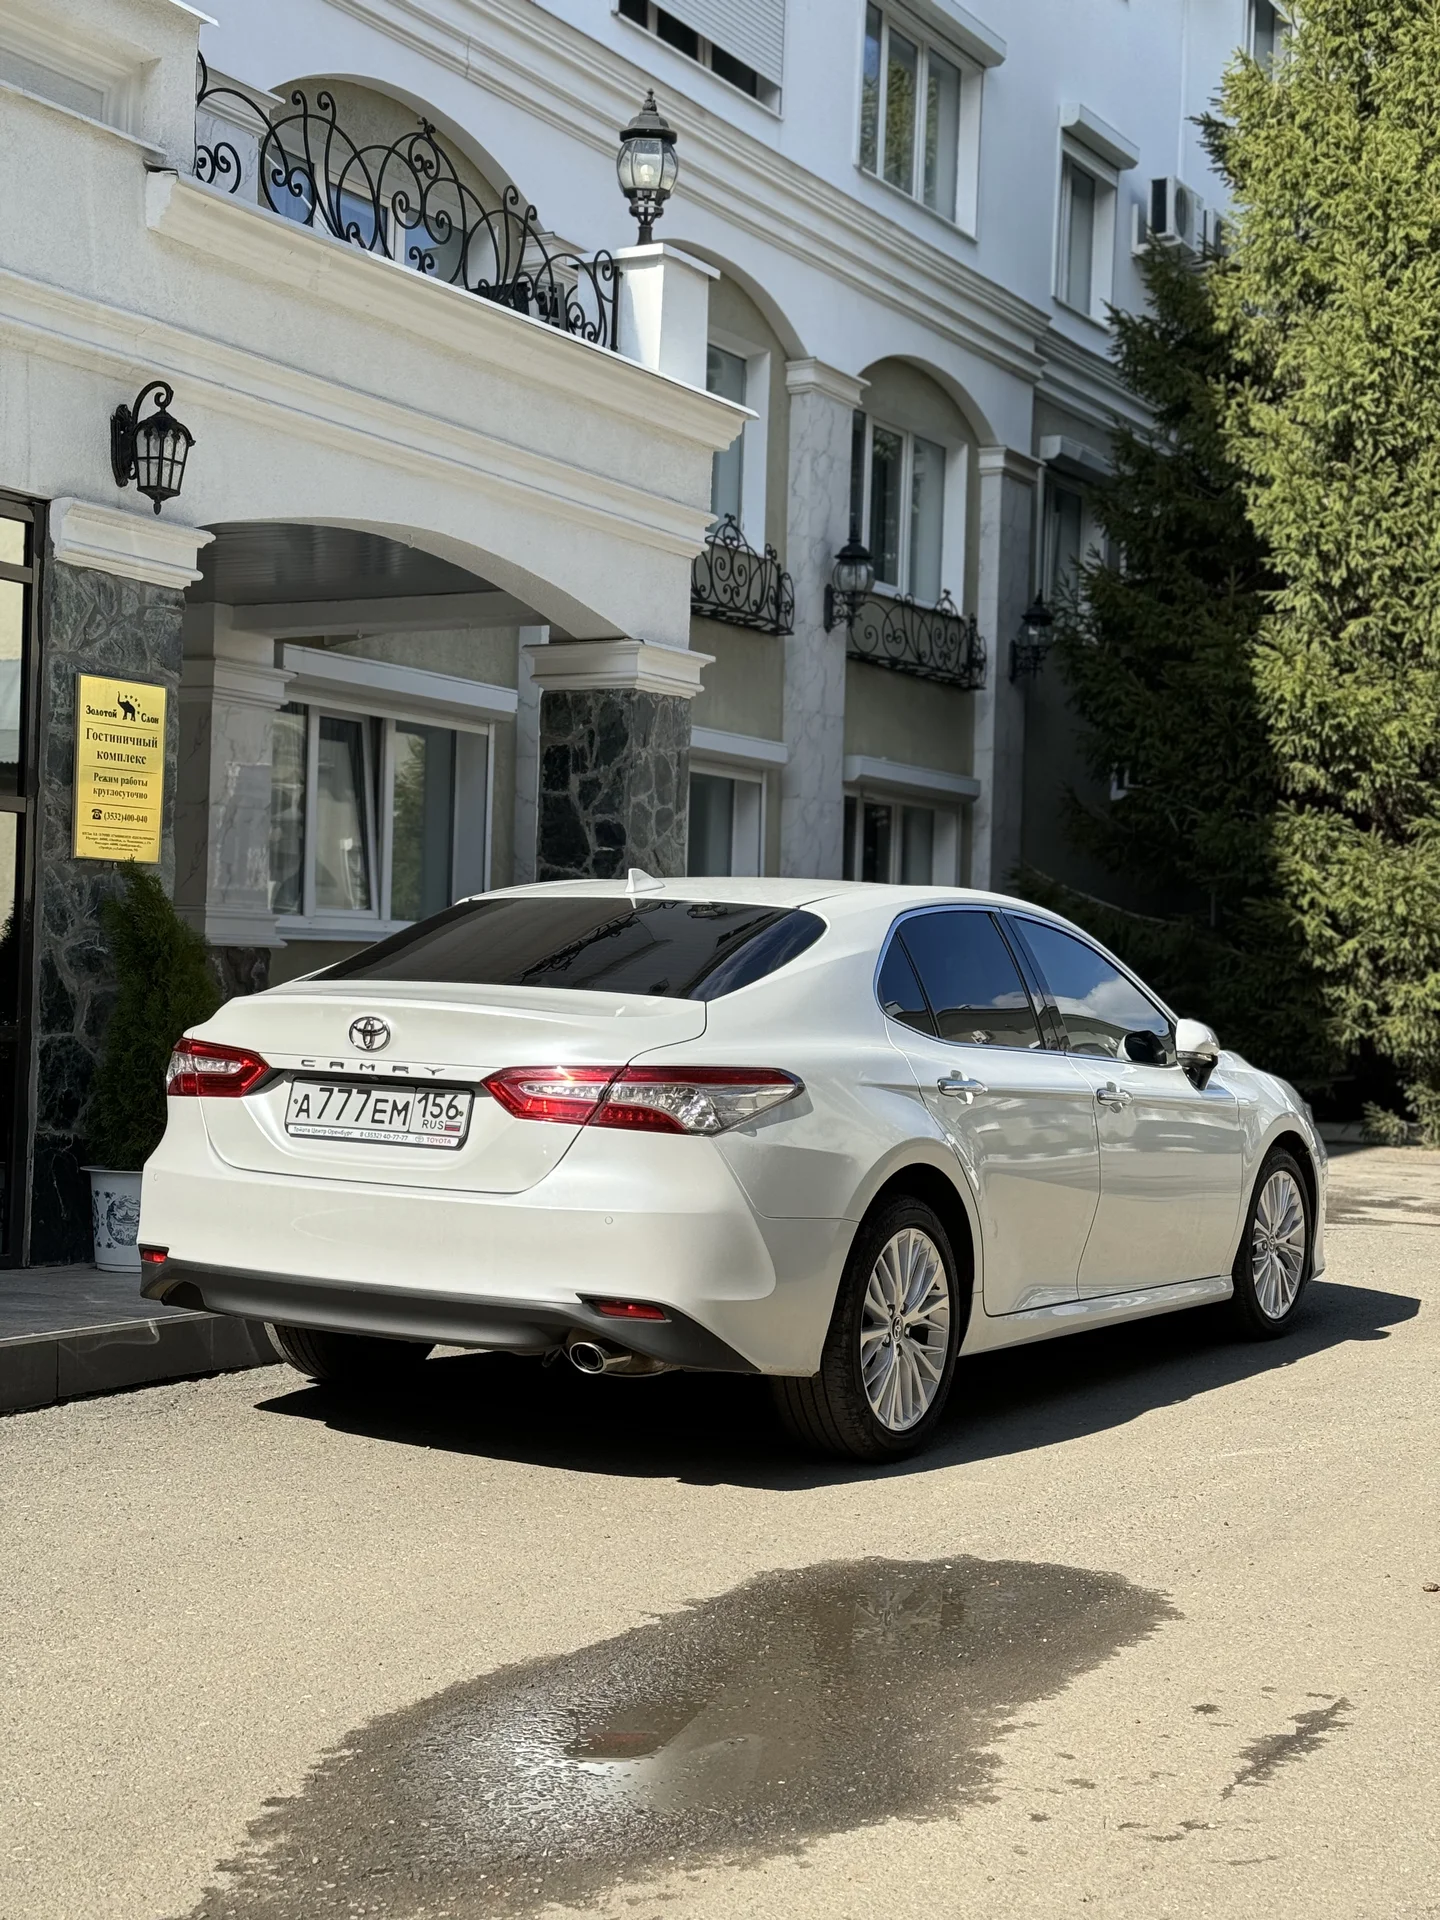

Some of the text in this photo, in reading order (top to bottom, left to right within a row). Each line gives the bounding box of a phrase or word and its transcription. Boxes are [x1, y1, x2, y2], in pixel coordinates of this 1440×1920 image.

[85, 704, 160, 725] Золотой Слон
[85, 727, 158, 749] Гостиничный
[96, 750, 147, 765] комплекс
[93, 772, 148, 787] Режим работы
[92, 787, 148, 800] круглосуточно
[300, 1058, 446, 1076] CAMRY
[417, 1092, 460, 1120] 156
[422, 1119, 444, 1130] RUS
[293, 1126, 311, 1134] Тойота
[311, 1127, 327, 1135] Центр
[327, 1128, 354, 1137] Оренбург
[383, 1133, 409, 1141] 40-77-77
[426, 1136, 452, 1145] TOYOTA
